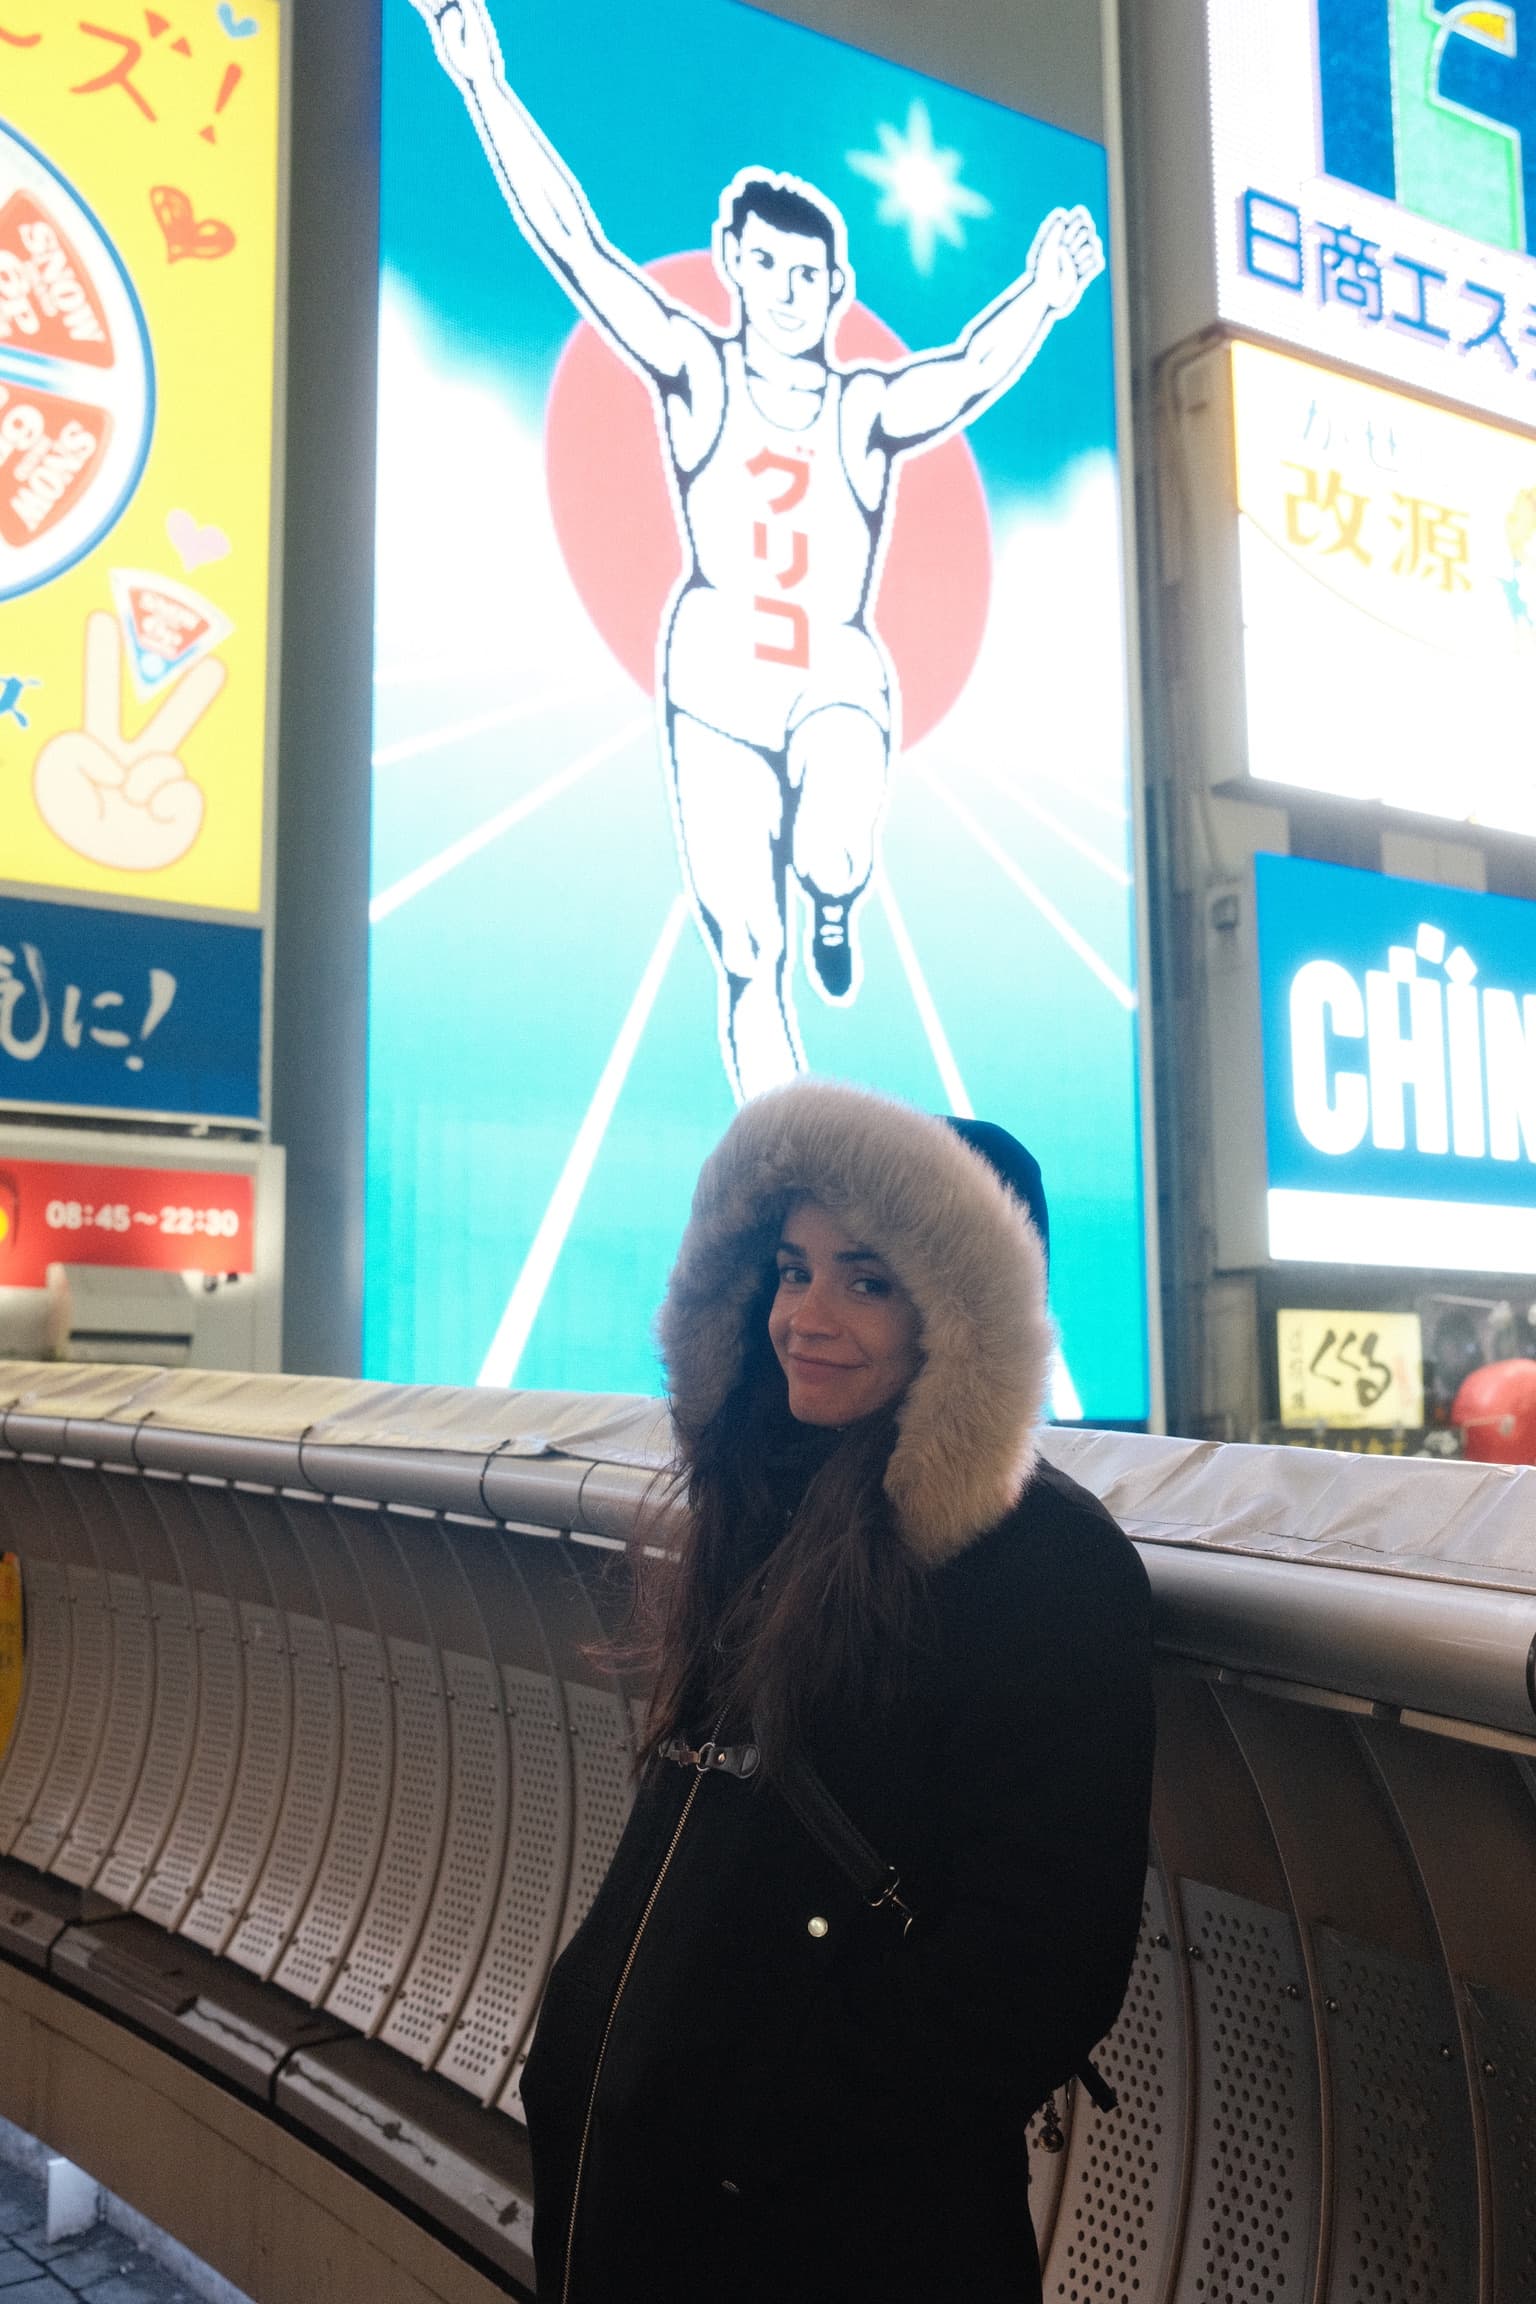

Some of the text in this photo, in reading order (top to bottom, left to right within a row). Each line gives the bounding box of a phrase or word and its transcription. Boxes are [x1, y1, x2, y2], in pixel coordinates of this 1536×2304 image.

[18, 221, 105, 343] SNOW
[1242, 185, 1536, 380] 日商エス
[10, 420, 97, 533] SNOW
[1280, 459, 1473, 592] 改源
[744, 445, 815, 670] グリコ
[1310, 1329, 1391, 1407] くくる
